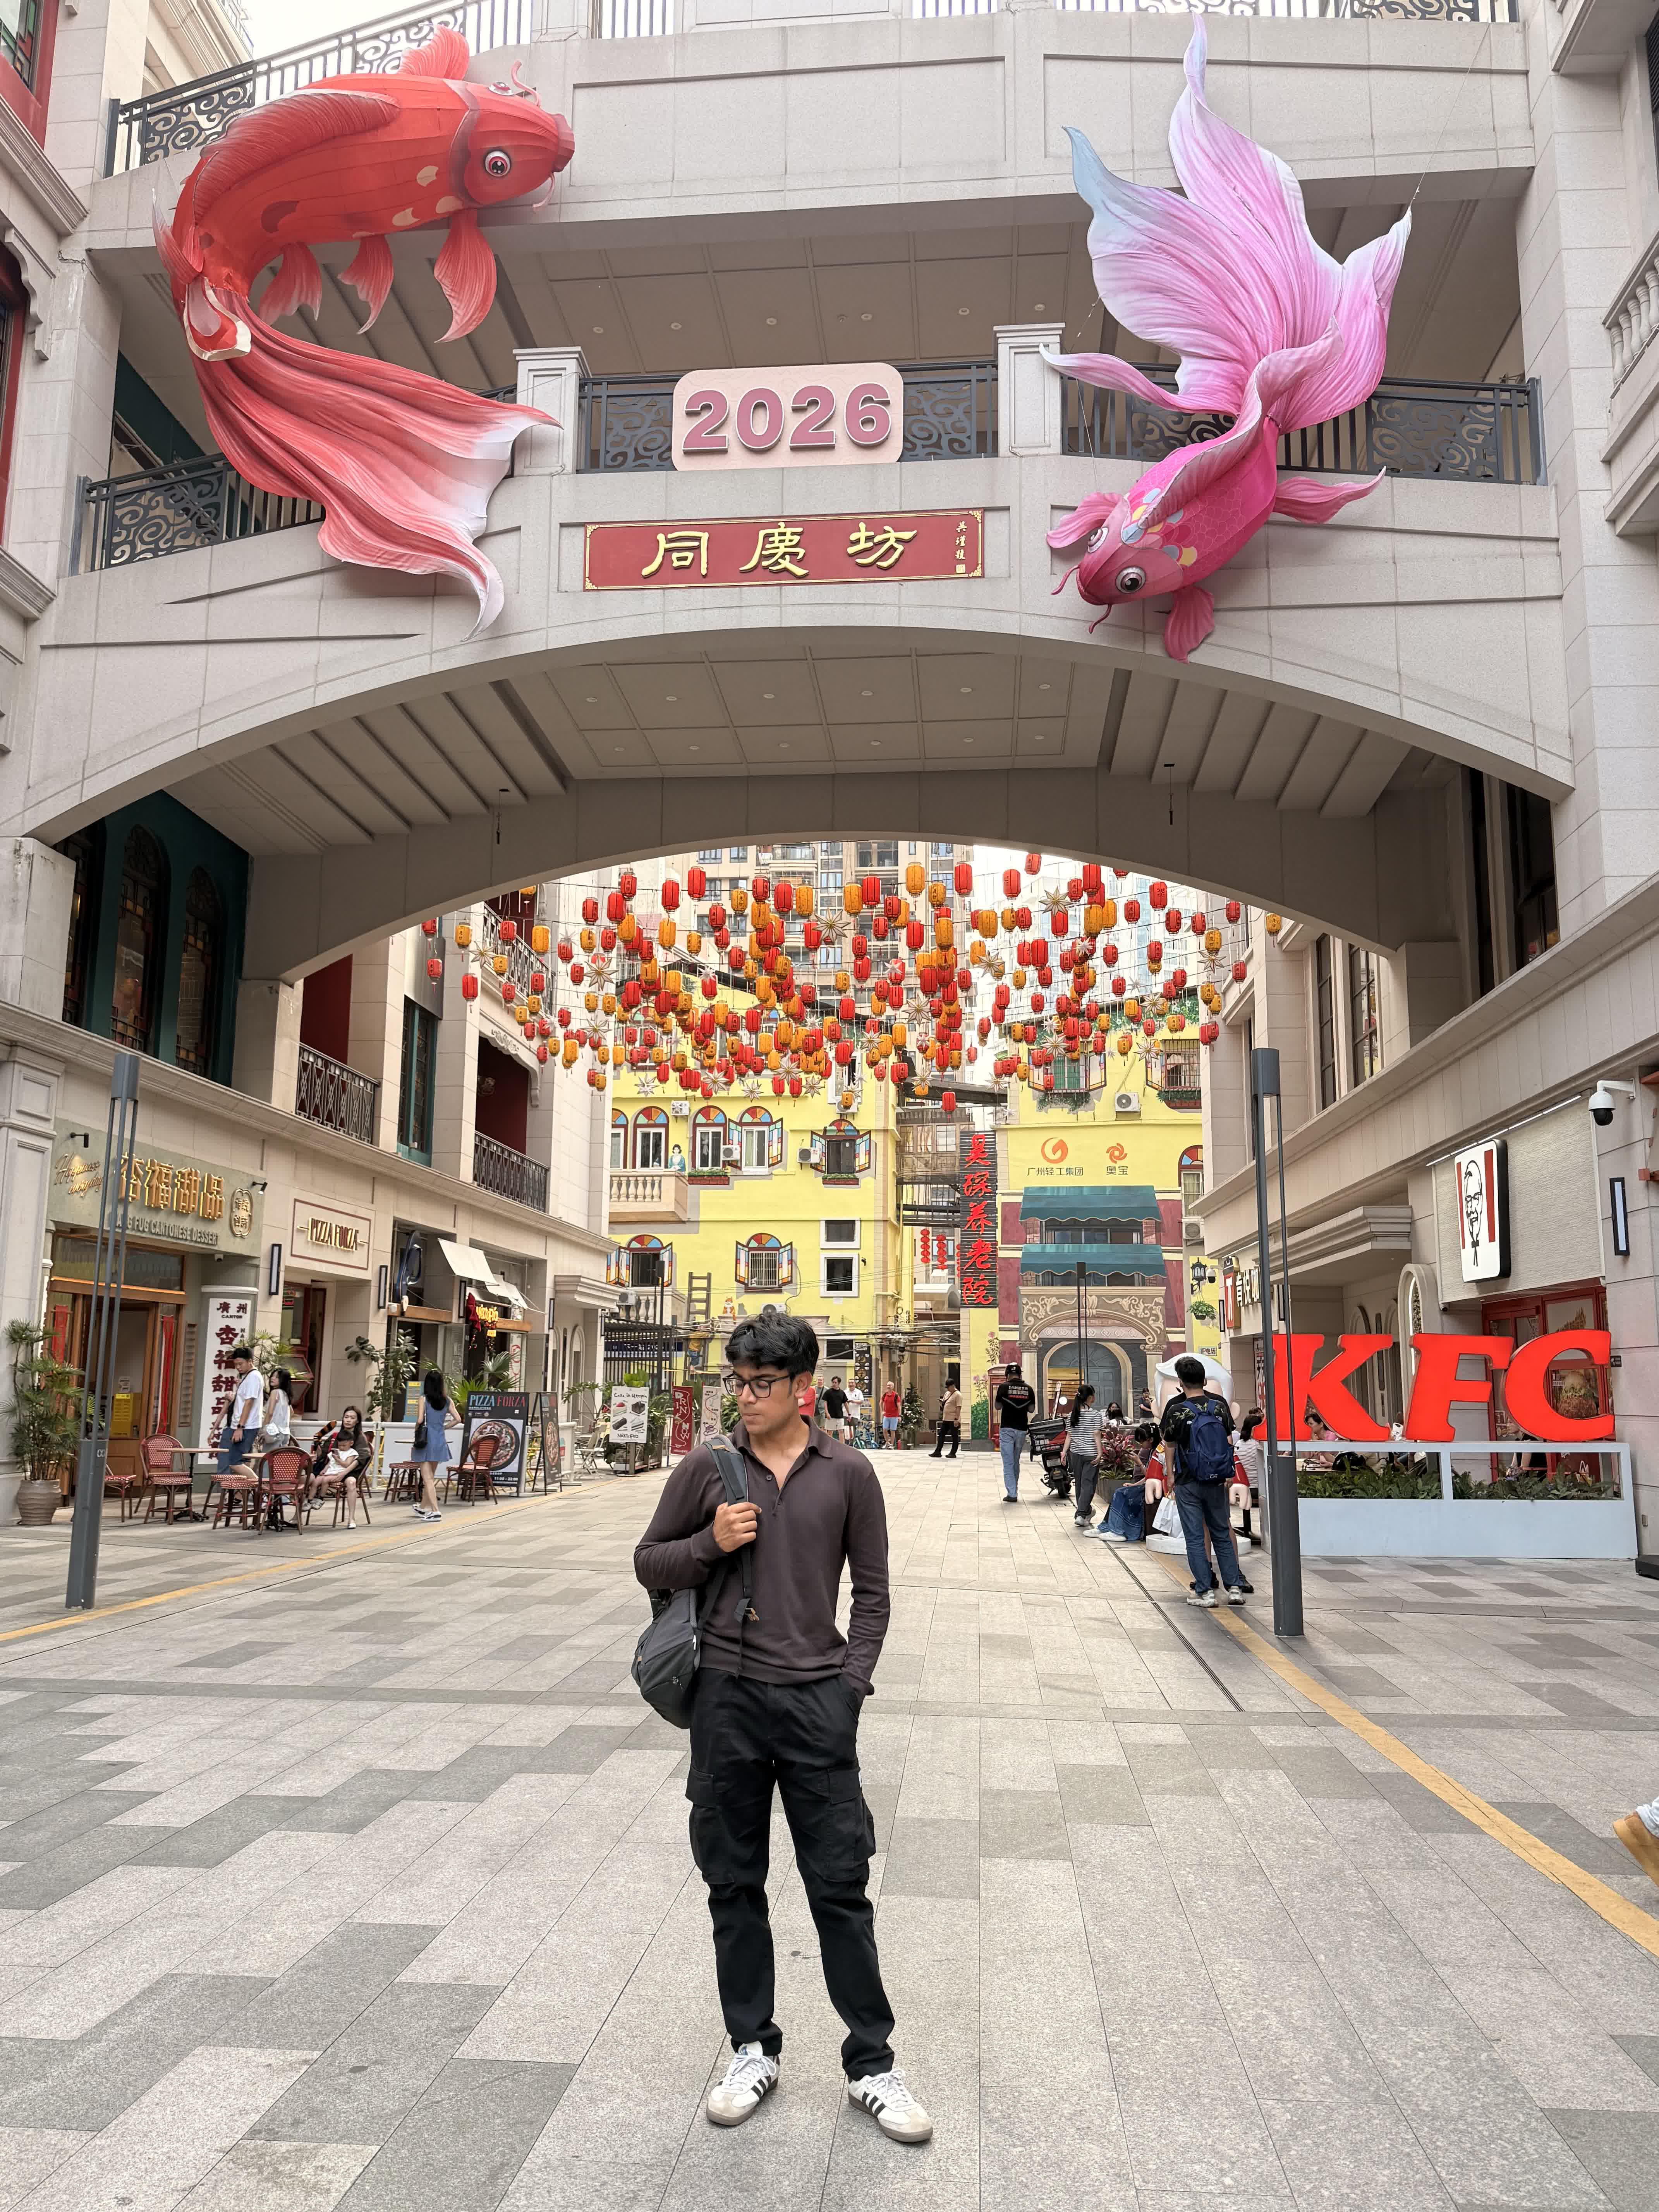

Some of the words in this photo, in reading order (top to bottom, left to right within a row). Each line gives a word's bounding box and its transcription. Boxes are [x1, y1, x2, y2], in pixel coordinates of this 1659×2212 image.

[682, 383, 892, 454] 2026
[1027, 1167, 1084, 1176] 广州轻工集团
[1106, 1166, 1128, 1175] 奥宝
[309, 1217, 333, 1245] PIZZA
[1252, 1329, 1615, 1442] KFC
[469, 1395, 495, 1407] PIZZA
[497, 1396, 525, 1407] FORZA
[680, 1422, 690, 1440] NOW
